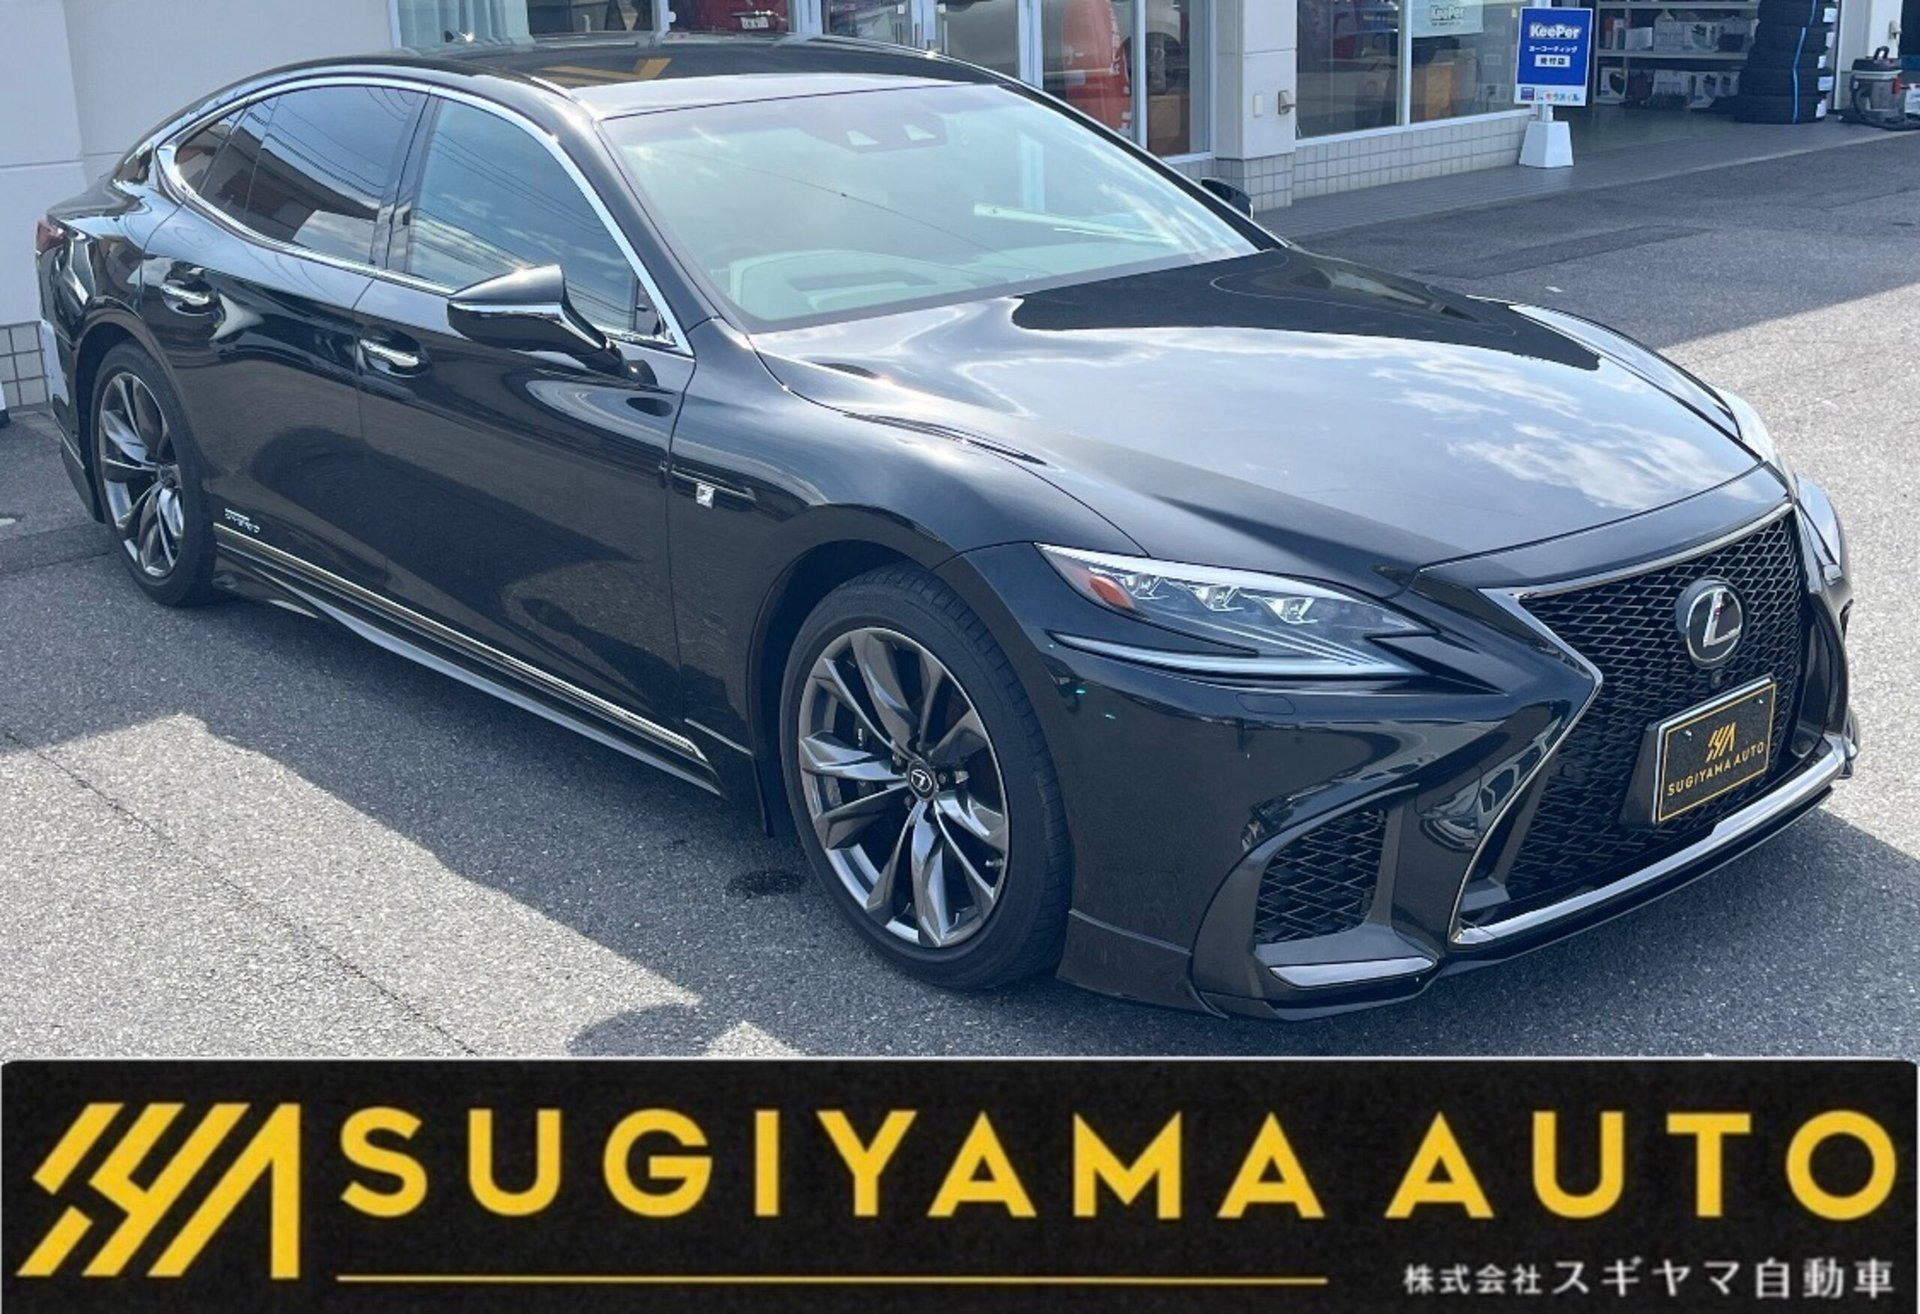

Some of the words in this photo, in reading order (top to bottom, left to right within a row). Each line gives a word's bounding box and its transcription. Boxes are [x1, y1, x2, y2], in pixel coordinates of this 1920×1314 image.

[1529, 23, 1582, 39] KeePer
[1667, 758, 1731, 796] SUGIYAMA
[1733, 741, 1765, 766] AUTO
